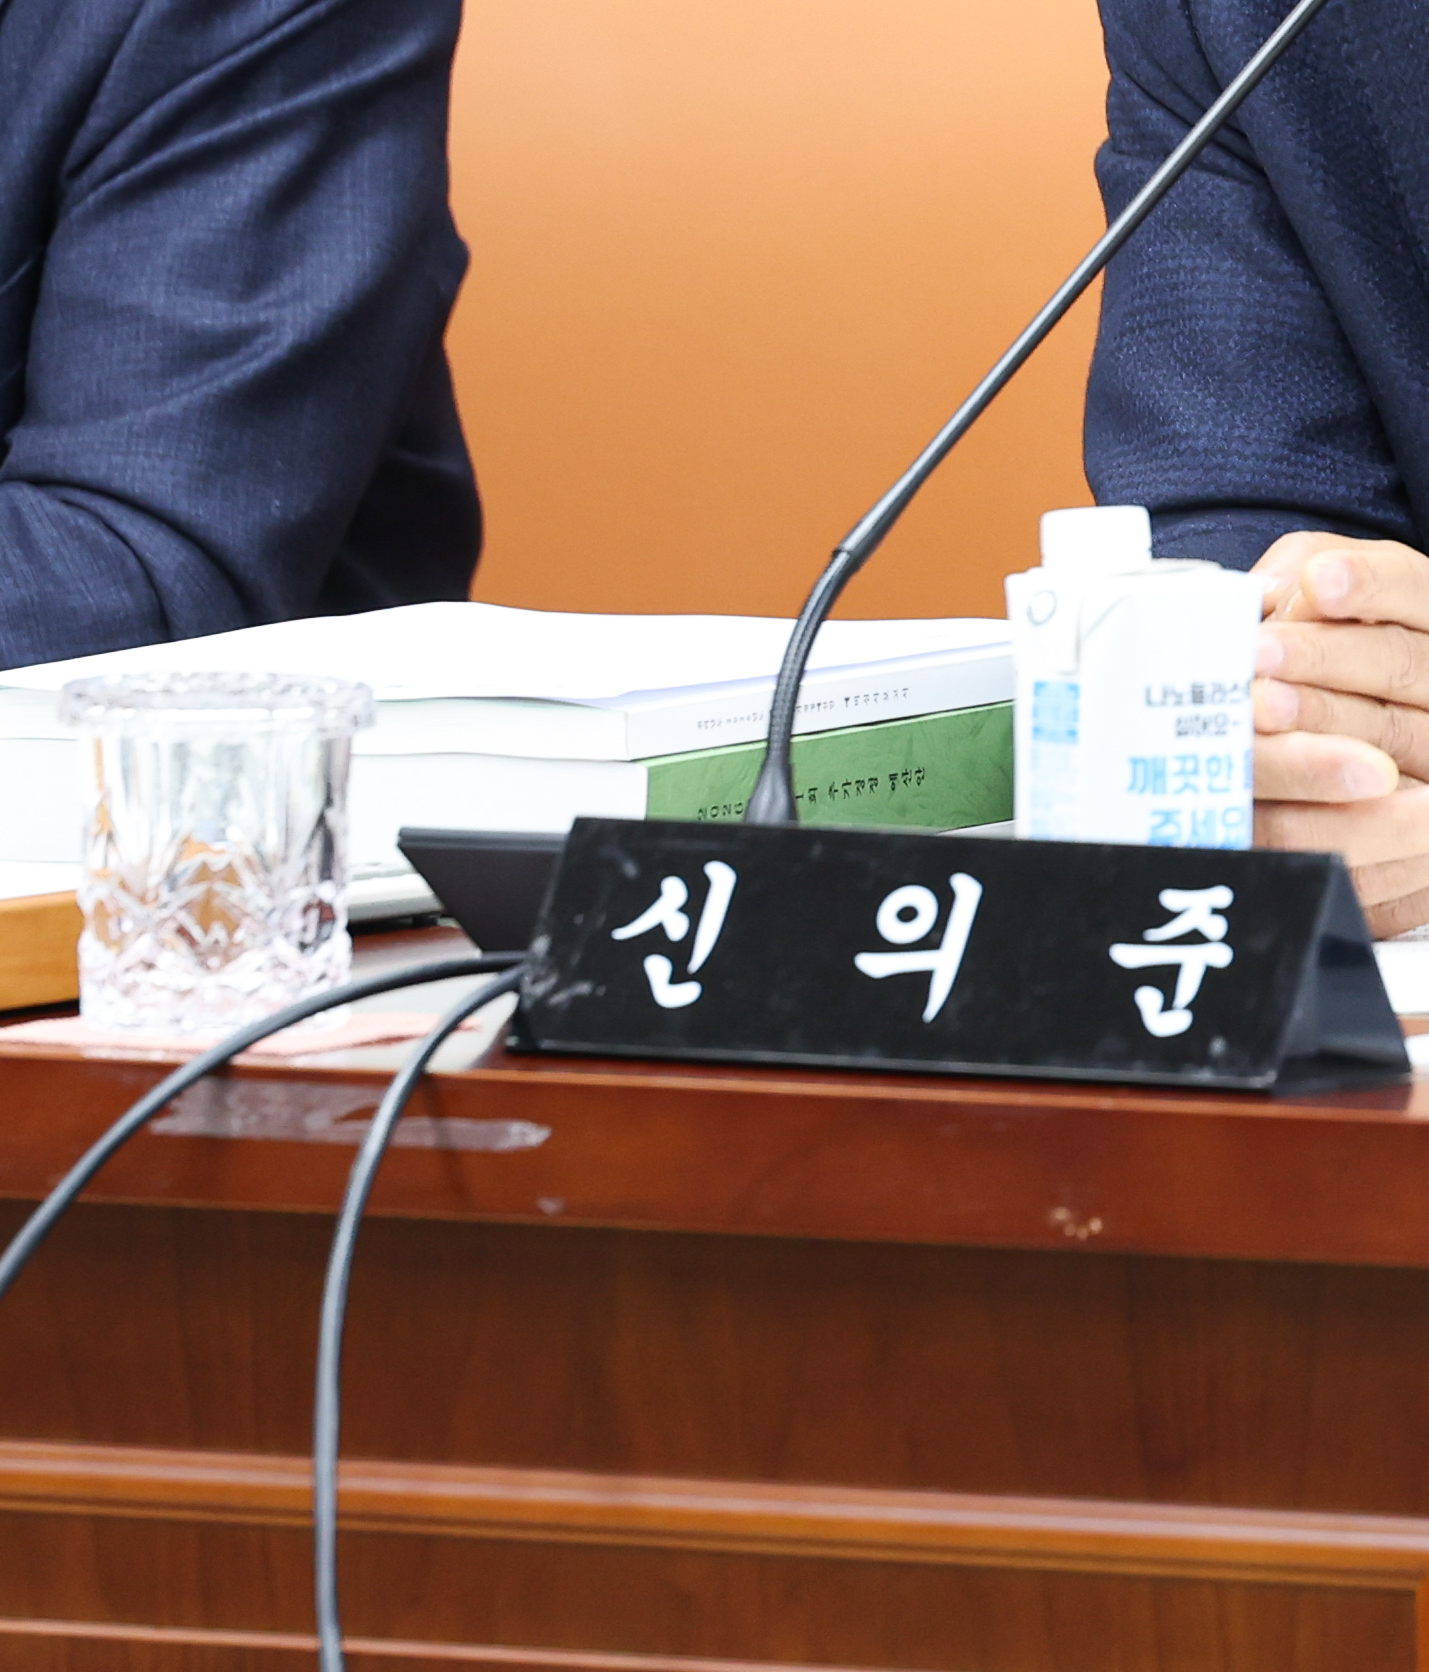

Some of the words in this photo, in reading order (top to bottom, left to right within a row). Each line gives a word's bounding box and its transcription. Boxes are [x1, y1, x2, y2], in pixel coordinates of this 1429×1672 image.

[827, 776, 879, 802] 추가경정
[888, 766, 926, 792] 예산안
[612, 861, 1233, 1037] 신의준
